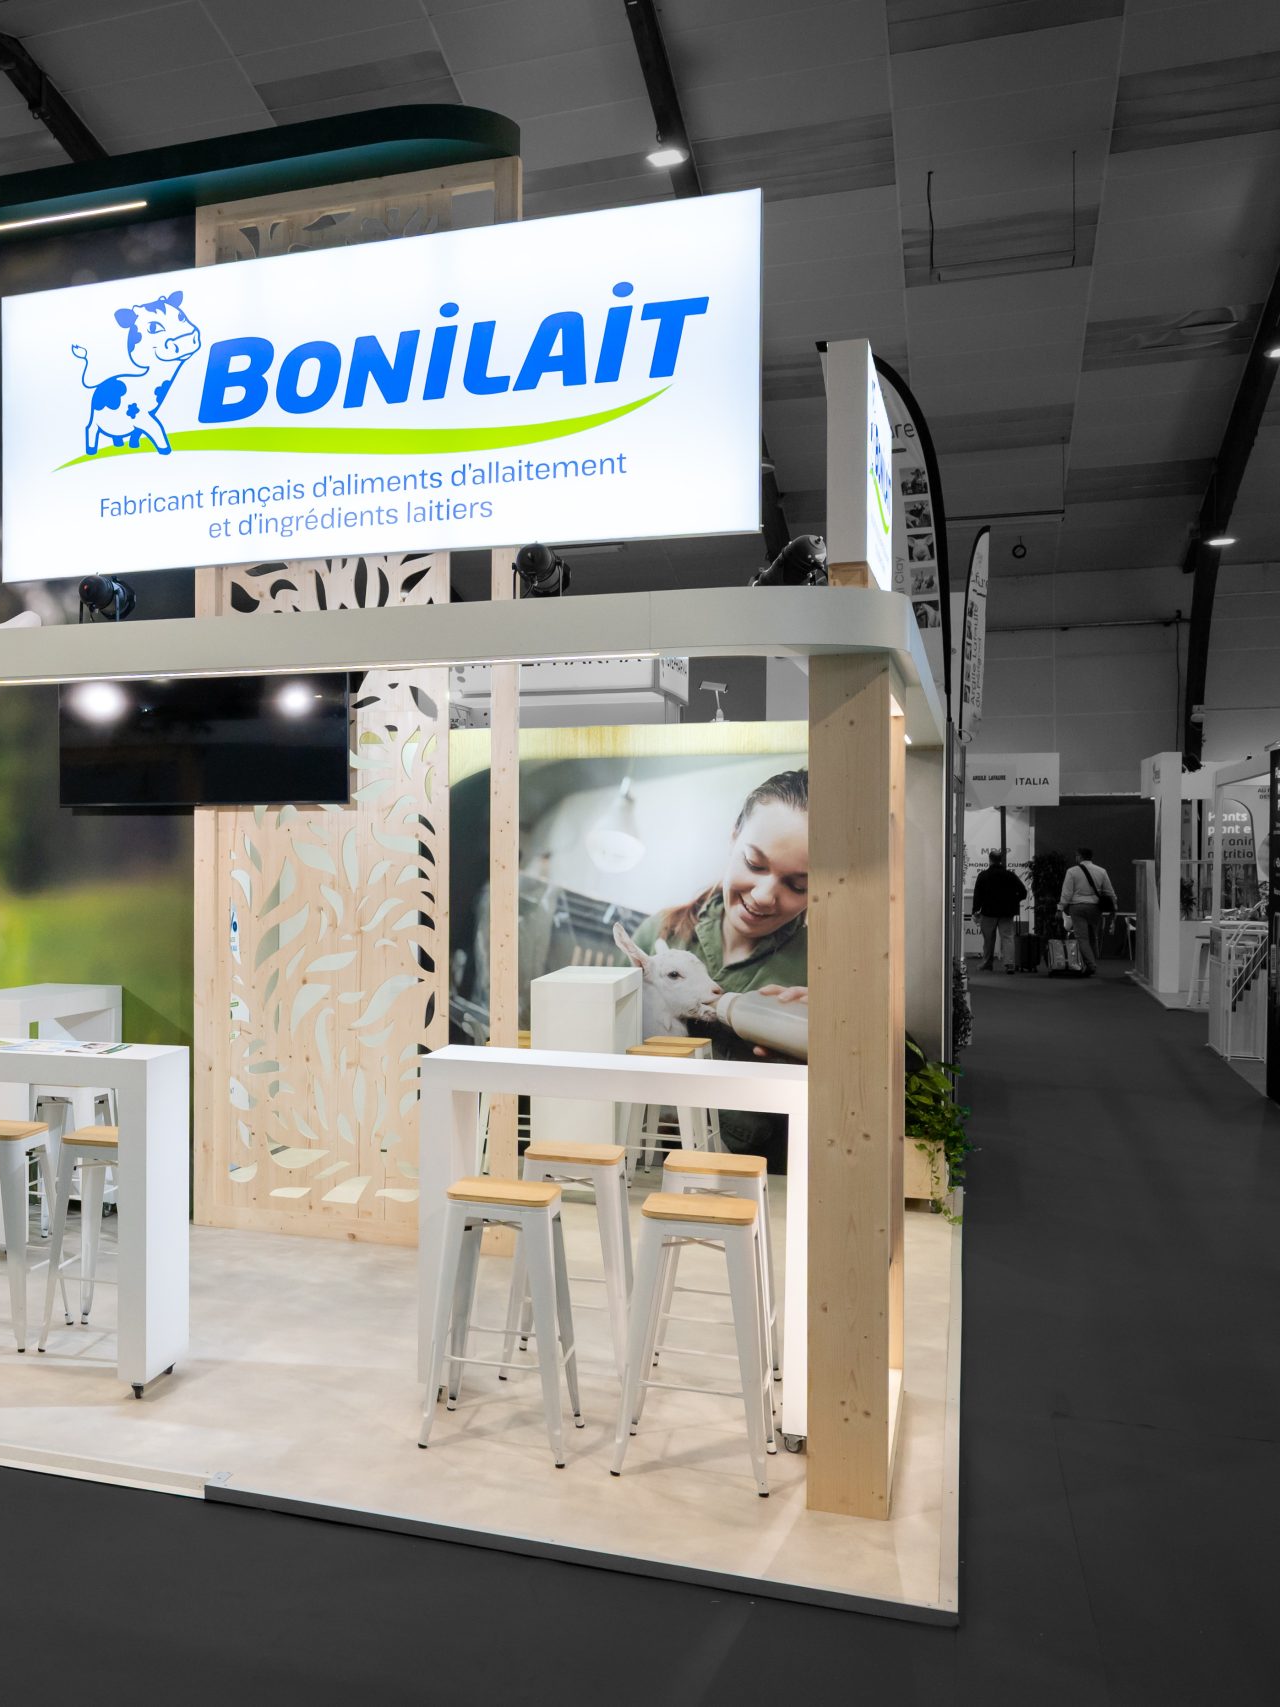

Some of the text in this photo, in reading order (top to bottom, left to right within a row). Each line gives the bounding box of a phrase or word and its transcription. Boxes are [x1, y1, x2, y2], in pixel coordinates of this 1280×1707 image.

[99, 452, 628, 519] Fabricant français d'aliments d'allaitement
[207, 496, 494, 540] et d'ingrédients laitiers
[1015, 777, 1050, 786] ITALIA
[1208, 824, 1240, 836] pant
